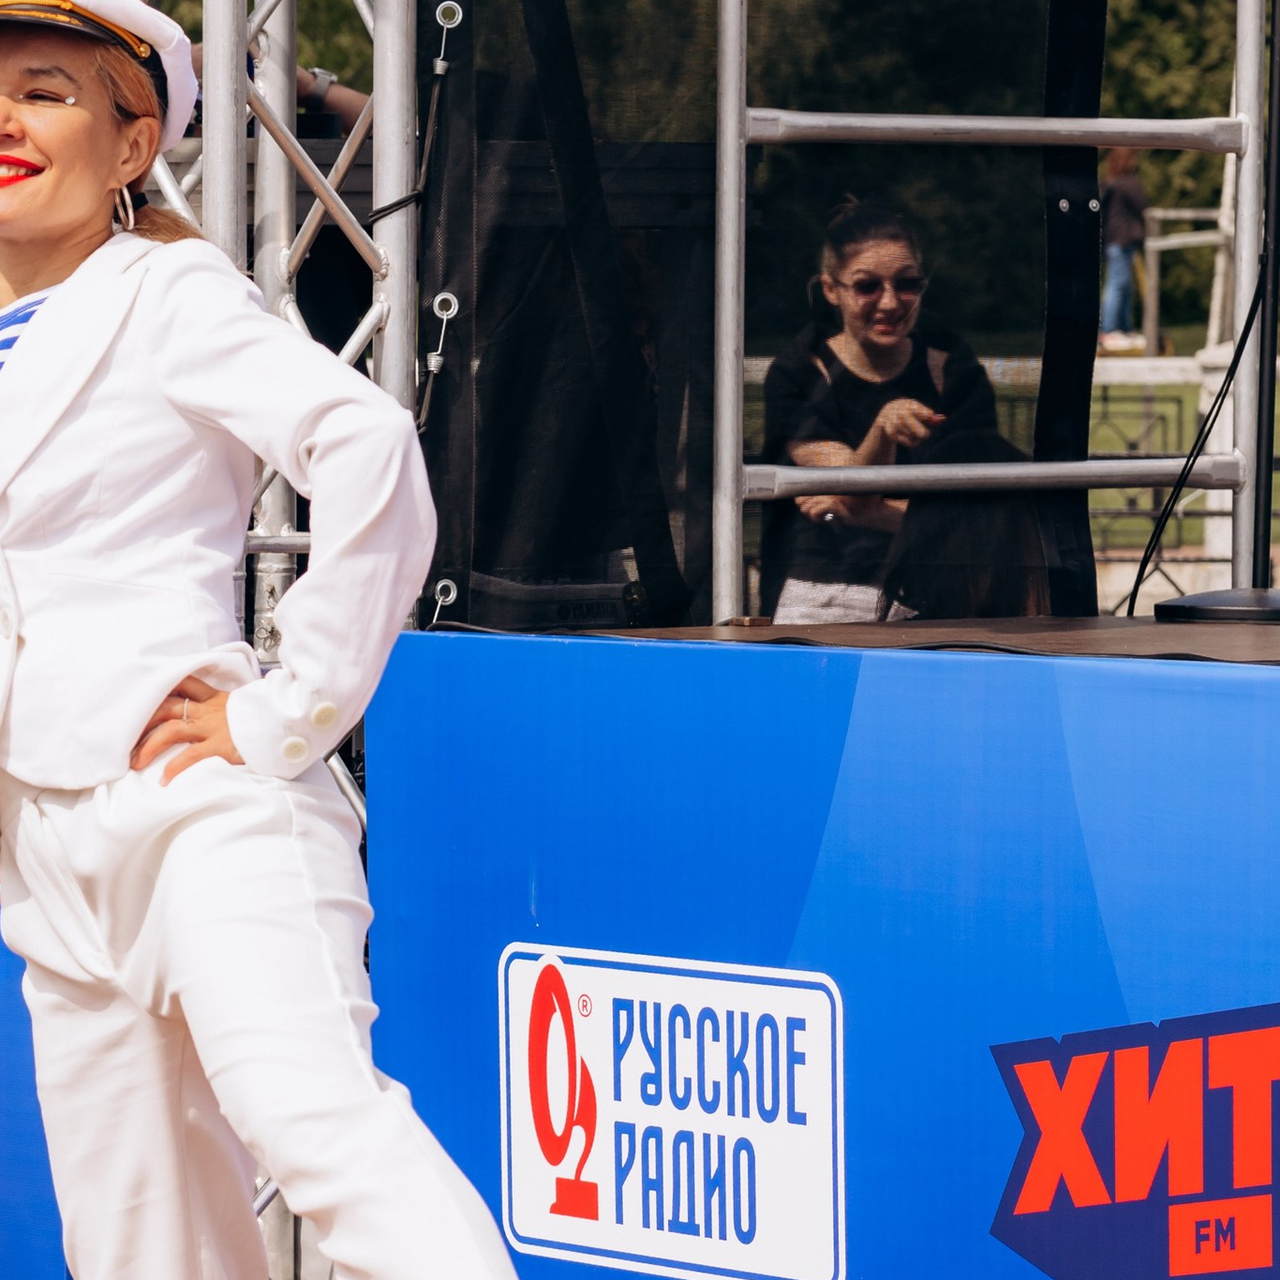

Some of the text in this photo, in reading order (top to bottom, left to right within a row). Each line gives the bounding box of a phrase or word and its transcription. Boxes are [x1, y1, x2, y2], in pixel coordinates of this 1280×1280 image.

[612, 997, 808, 1126] РУССКОЕ
[1013, 1026, 1280, 1216] ХИТ
[614, 1120, 757, 1245] РАДИО
[1195, 1216, 1236, 1255] FM
